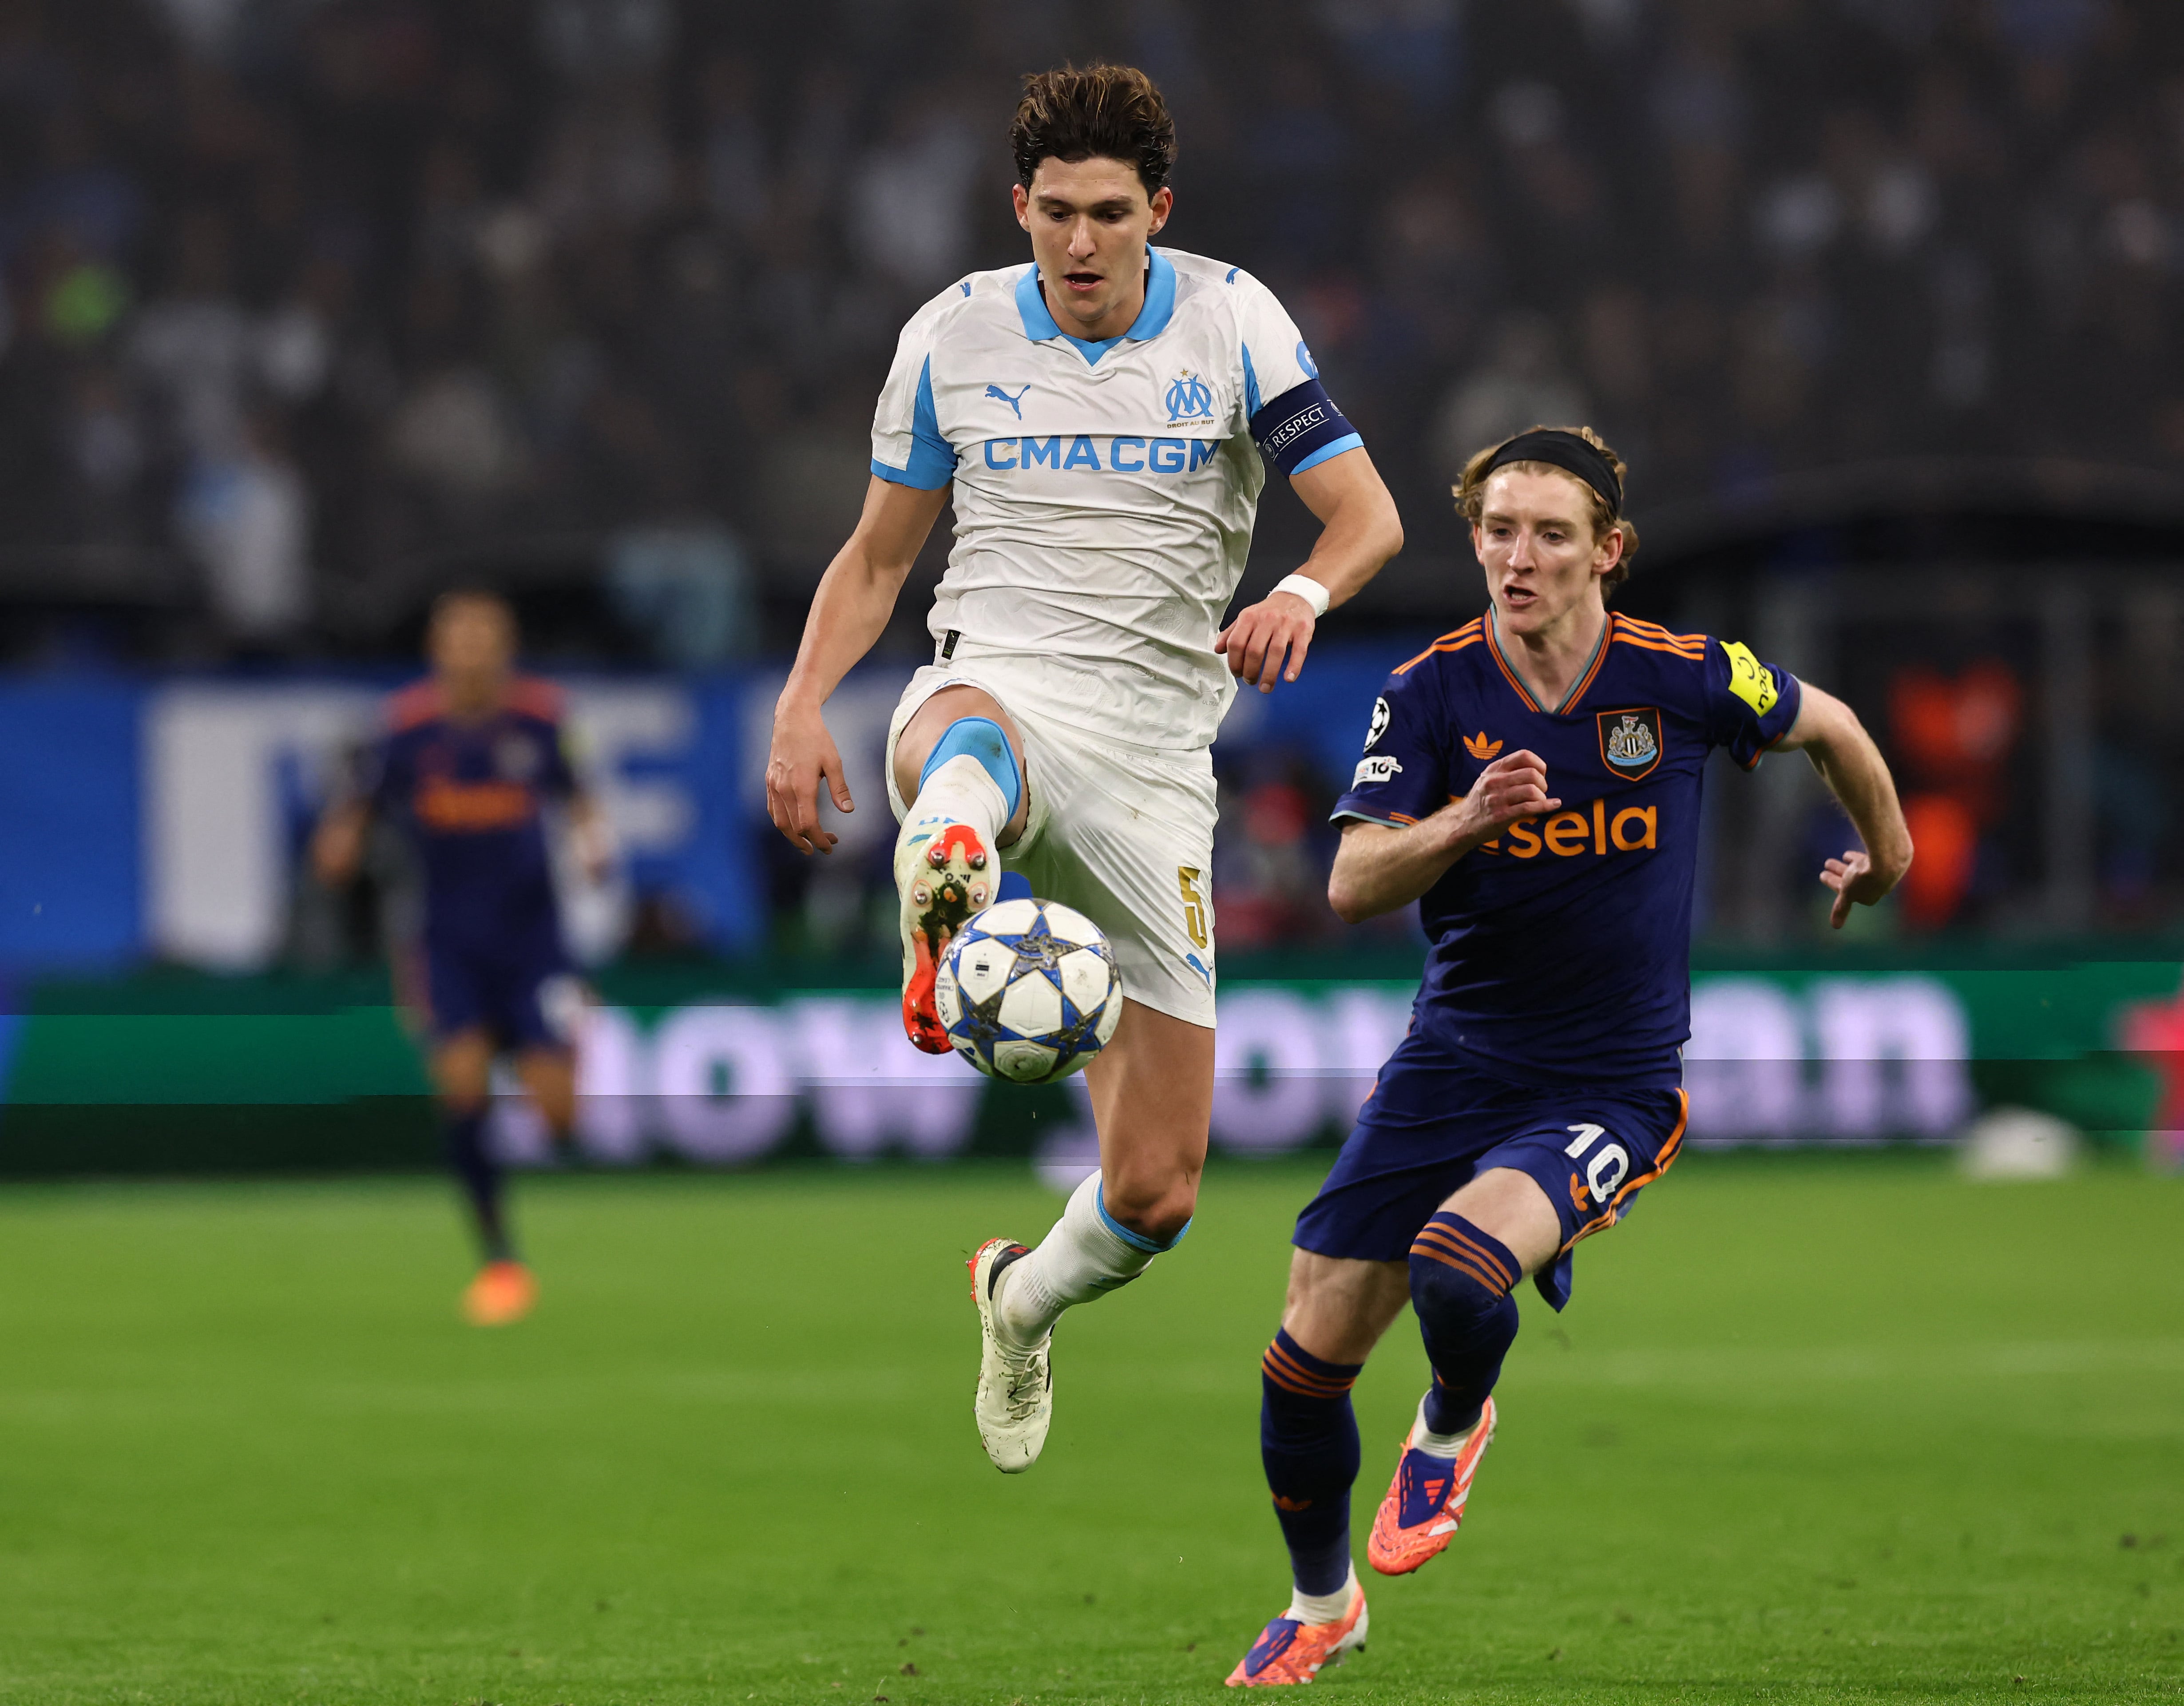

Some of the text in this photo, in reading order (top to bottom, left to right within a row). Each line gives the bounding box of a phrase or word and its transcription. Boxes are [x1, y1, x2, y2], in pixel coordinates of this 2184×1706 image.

[1272, 407, 1325, 447] RESPECT
[984, 435, 1221, 473] CMA CGM
[1758, 666, 1769, 710] noo
[1371, 762, 1389, 774] 10
[1508, 799, 1657, 858] sela
[1177, 866, 1208, 949] 5
[1564, 1123, 1629, 1203] 10
